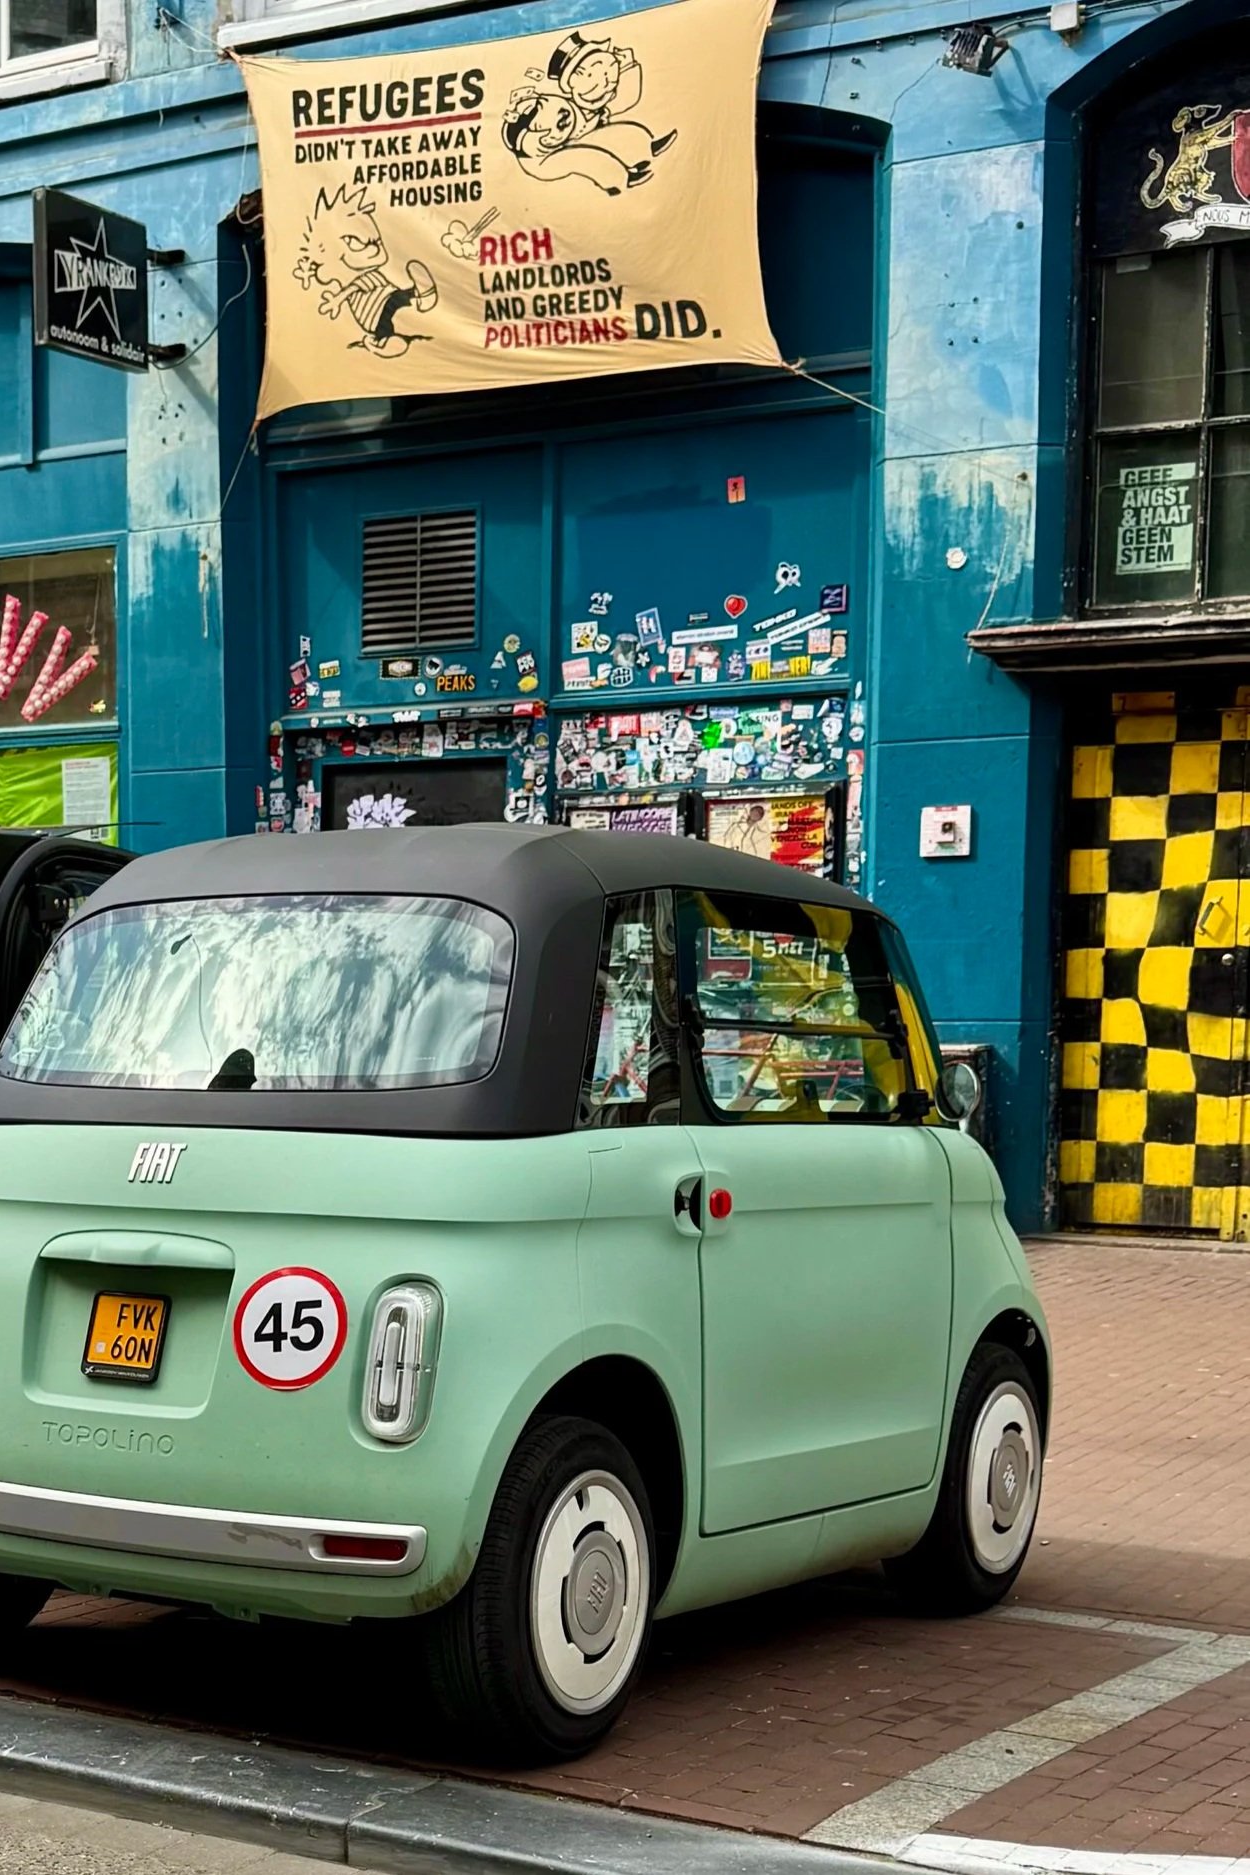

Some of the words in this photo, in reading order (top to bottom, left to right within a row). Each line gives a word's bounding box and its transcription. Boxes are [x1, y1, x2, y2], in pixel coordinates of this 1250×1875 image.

[291, 67, 486, 128] REFUGEES
[294, 138, 356, 164] DIDN'T
[361, 135, 413, 159] TAKE
[417, 125, 482, 154] AWAY
[352, 153, 482, 186] AFFORDABLE
[390, 180, 482, 208] HOUSING
[479, 227, 555, 267] RICH
[479, 257, 612, 295] LANDLORDS
[484, 296, 526, 323] AND
[532, 285, 624, 319] GREEDY
[484, 315, 629, 350] POLITICIANS
[634, 299, 722, 341] DID.
[1121, 485, 1190, 508] ANGST
[1121, 508, 1137, 529] &
[1139, 504, 1192, 527] HAAT
[1121, 526, 1173, 546] GEEN
[1120, 544, 1174, 566] STEM
[436, 674, 476, 693] PEAKS
[127, 1142, 188, 1184] FIAT
[116, 1302, 158, 1332] FVK
[253, 1299, 325, 1353] 45
[110, 1334, 154, 1364] 60N
